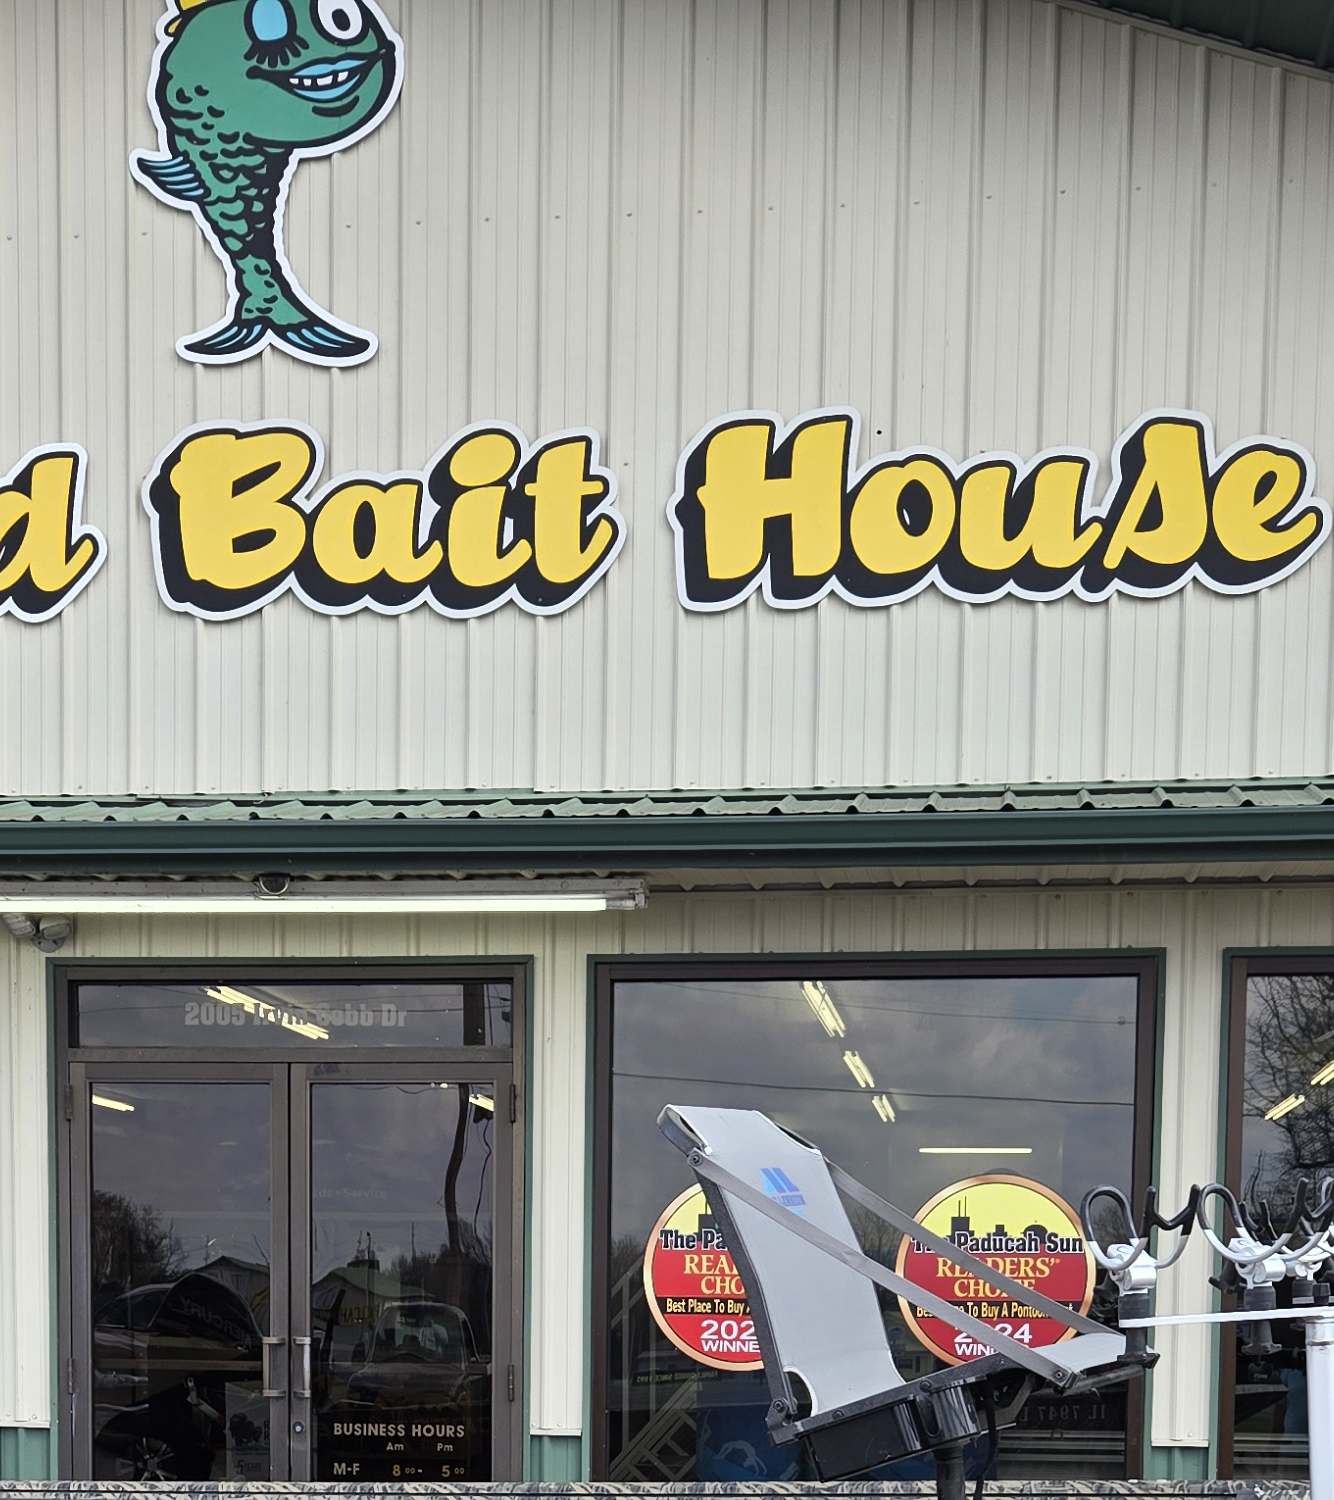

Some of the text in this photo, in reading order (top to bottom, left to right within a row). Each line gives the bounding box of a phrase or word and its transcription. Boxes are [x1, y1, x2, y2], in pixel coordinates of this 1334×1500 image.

[147, 422, 622, 614] Bait
[670, 412, 1329, 610] House
[184, 1001, 246, 1027] 2005
[315, 1002, 373, 1027] Cobb
[380, 1002, 408, 1028] Dr
[659, 1228, 697, 1251] The
[954, 1231, 1041, 1254] Paducah
[1045, 1231, 1085, 1254] Sun
[937, 1257, 1055, 1278] REDERS'
[666, 1298, 686, 1314] Best
[688, 1298, 712, 1314] Place
[714, 1299, 725, 1314] To
[727, 1299, 745, 1317] Buy
[967, 1301, 979, 1318] To
[981, 1302, 999, 1321] Buy
[1001, 1302, 1009, 1318] A
[700, 1319, 757, 1340] 202
[701, 1340, 761, 1353] WINNE
[333, 1422, 466, 1438] BUSINESS HOURS
[386, 1442, 454, 1452] Am Pm
[333, 1462, 360, 1476] M-F
[392, 1464, 401, 1477] 8
[441, 1464, 451, 1478] 5
